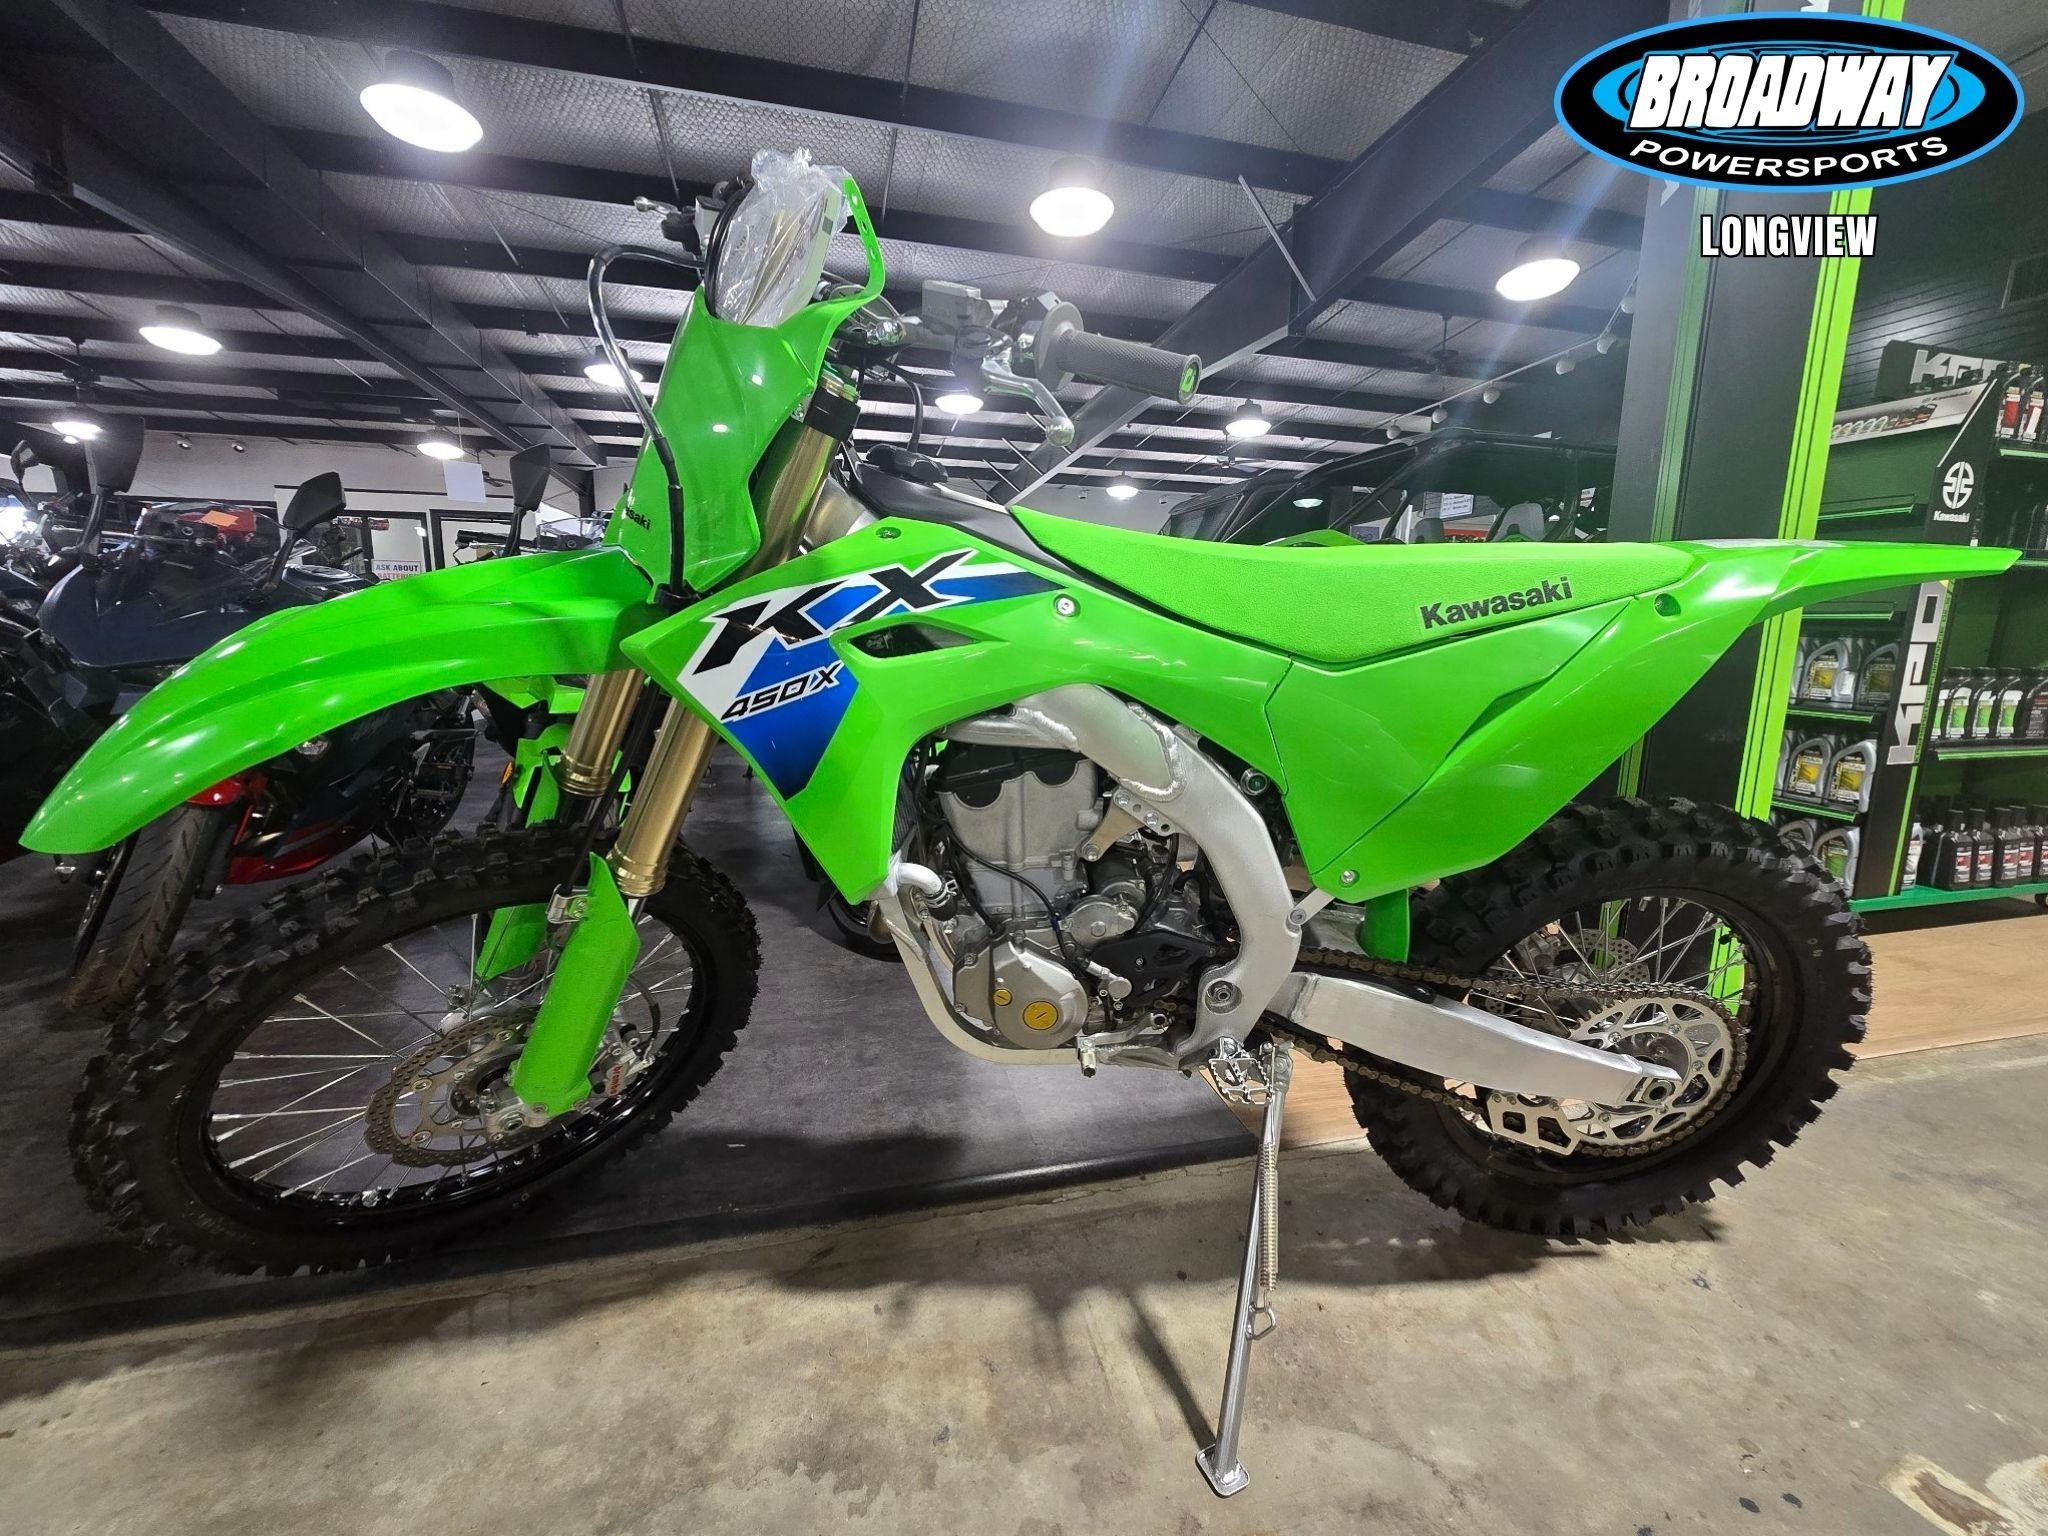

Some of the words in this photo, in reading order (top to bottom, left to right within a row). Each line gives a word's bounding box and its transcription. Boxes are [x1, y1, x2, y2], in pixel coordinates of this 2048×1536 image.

[1933, 510, 1970, 523] Kawasaki
[378, 572, 413, 580] BATTERI
[1419, 576, 1573, 629] Kawasaki
[692, 548, 977, 676] KX
[720, 661, 841, 722] 450X
